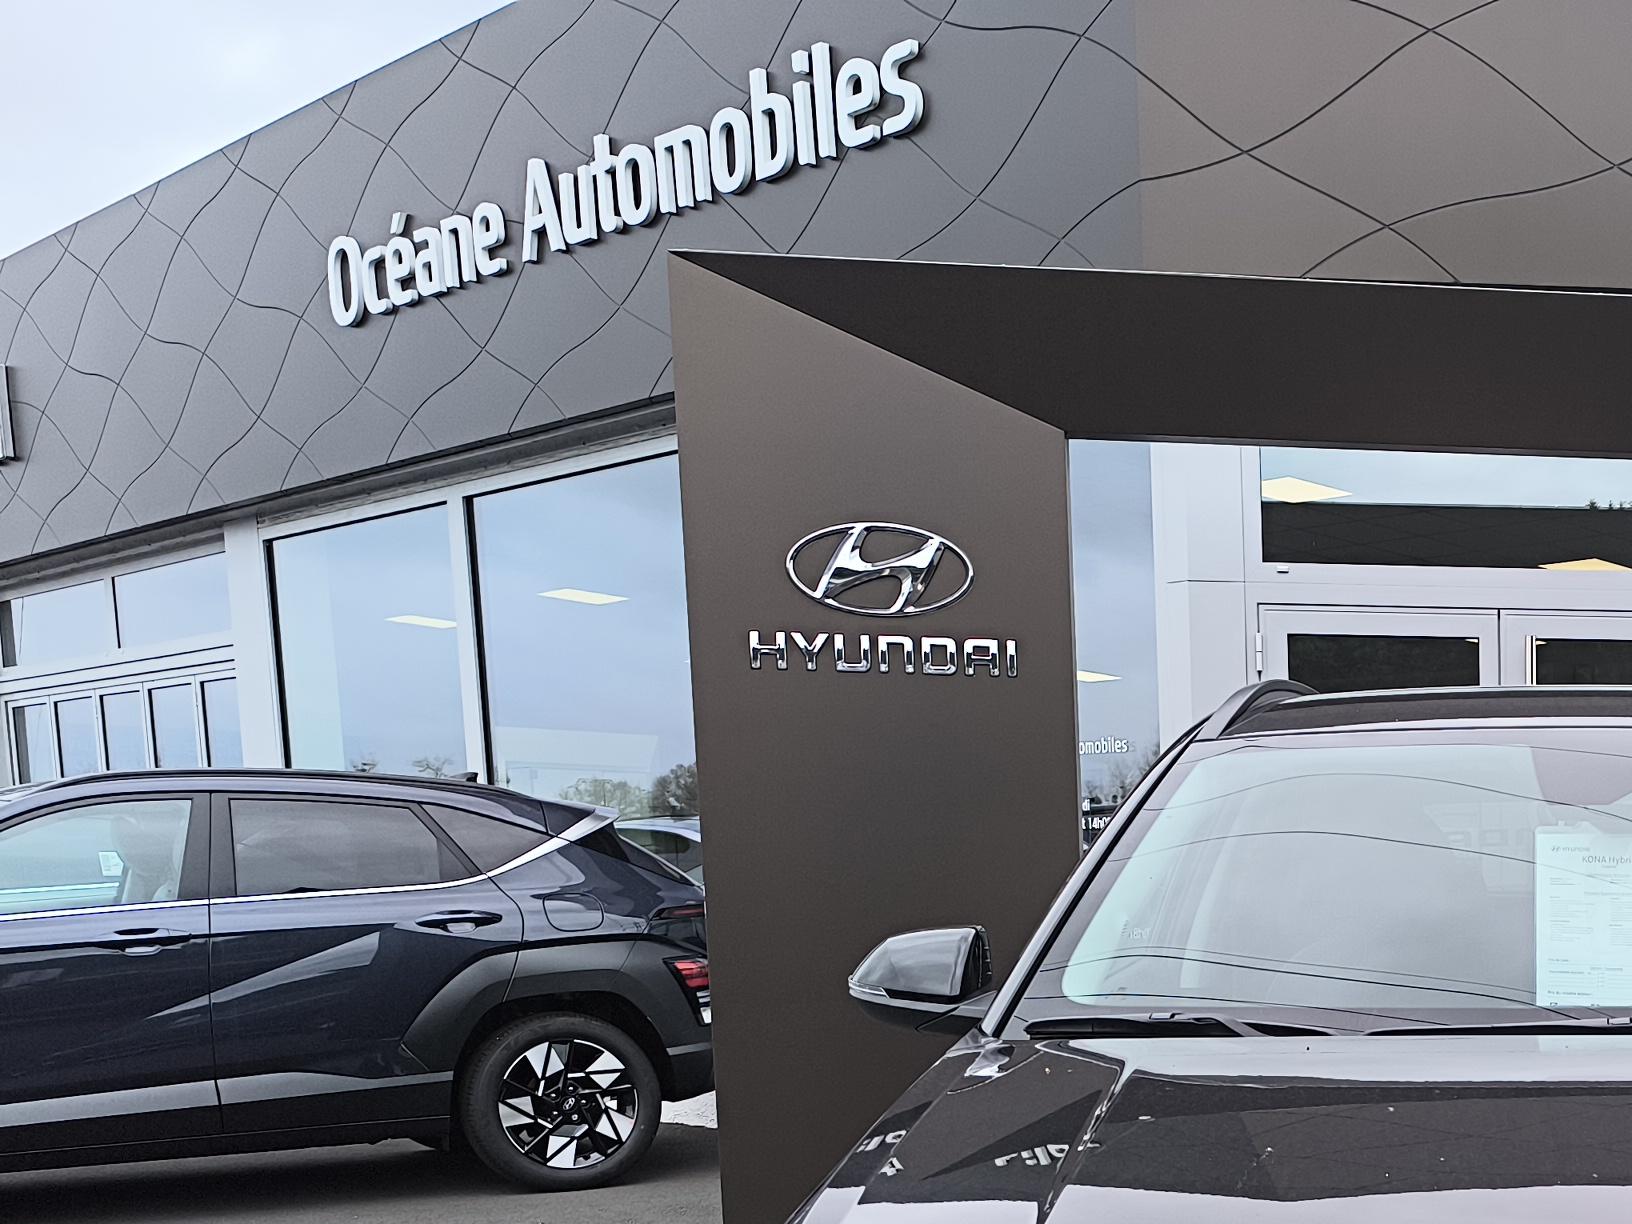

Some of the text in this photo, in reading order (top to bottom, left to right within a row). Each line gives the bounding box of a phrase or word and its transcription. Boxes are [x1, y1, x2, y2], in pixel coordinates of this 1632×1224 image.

[327, 38, 926, 328] Océane Automobiles
[748, 630, 1018, 678] HYUNDAI
[1582, 855, 1607, 864] KONA
